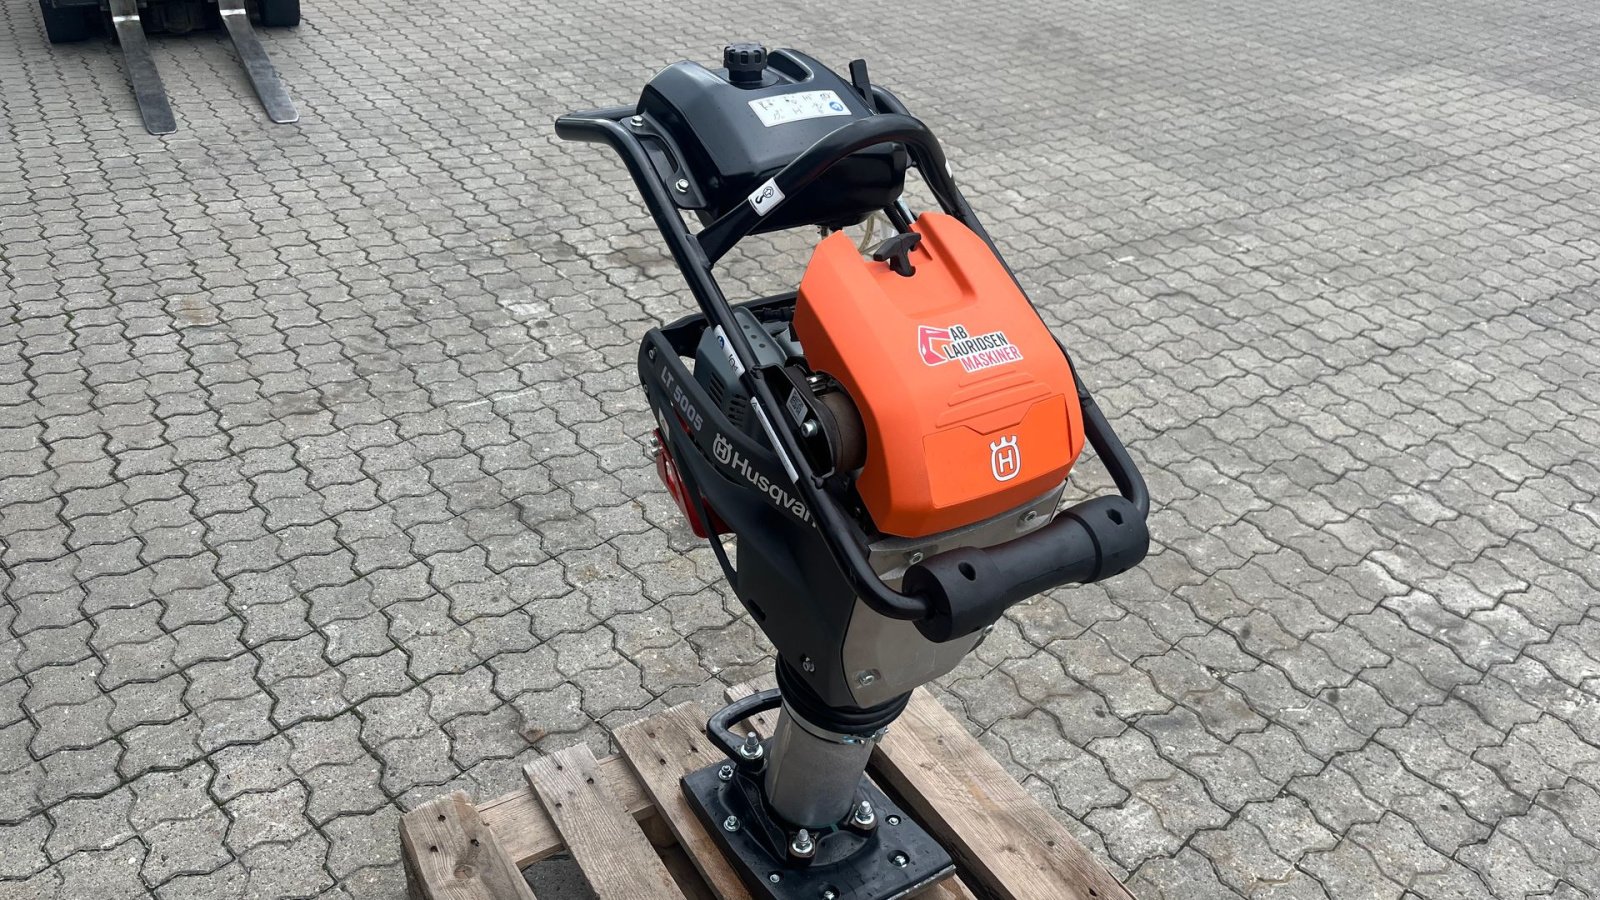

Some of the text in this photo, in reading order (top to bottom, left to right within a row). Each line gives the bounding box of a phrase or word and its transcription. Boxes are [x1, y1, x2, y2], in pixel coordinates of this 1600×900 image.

[943, 332, 1008, 359] LAURIDSEN
[949, 325, 968, 341] AB
[961, 345, 1021, 371] MASKINER
[661, 365, 704, 432] LT 5005
[731, 451, 817, 528] Husqvar
